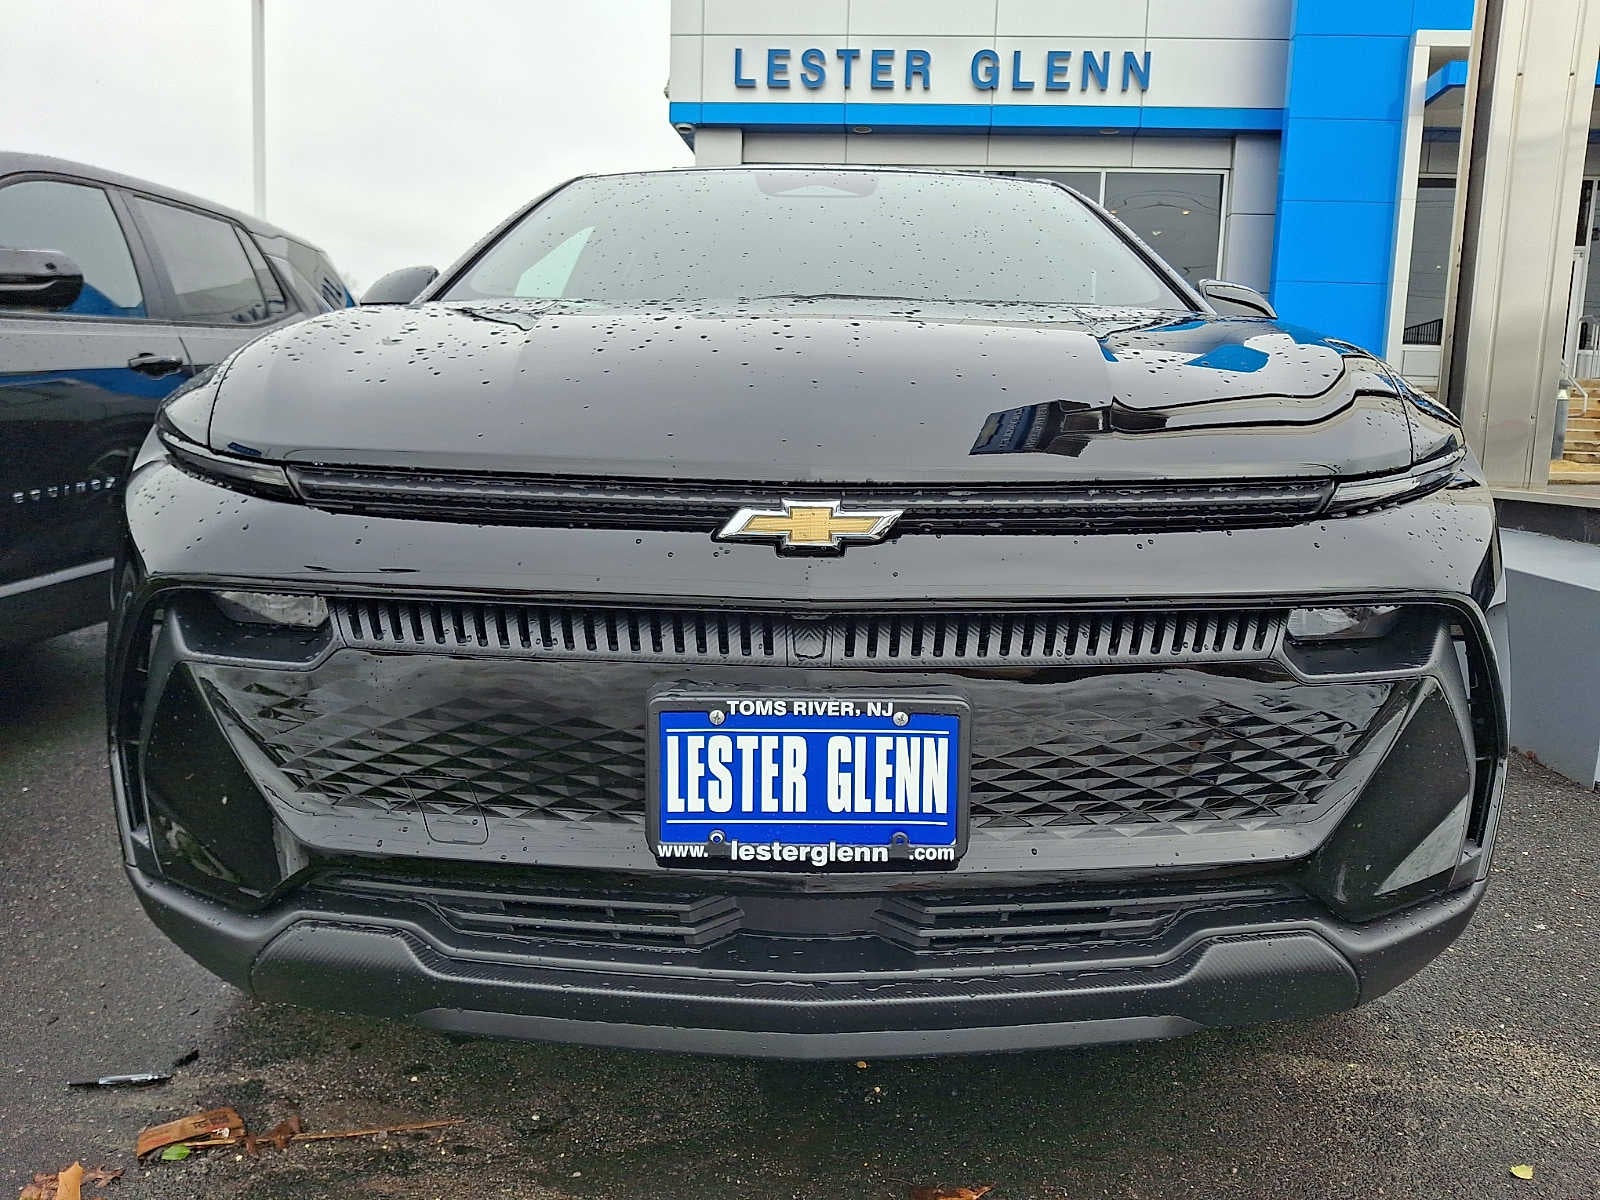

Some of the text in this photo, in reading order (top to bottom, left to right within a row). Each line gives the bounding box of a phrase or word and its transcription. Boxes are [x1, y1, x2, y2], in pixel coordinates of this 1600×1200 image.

[733, 47, 1152, 92] LESTER GLENN
[727, 701, 894, 718] TOMS RIVER, NJ
[667, 735, 949, 814] LESTER GLENN
[730, 841, 889, 867] lesterglenn
